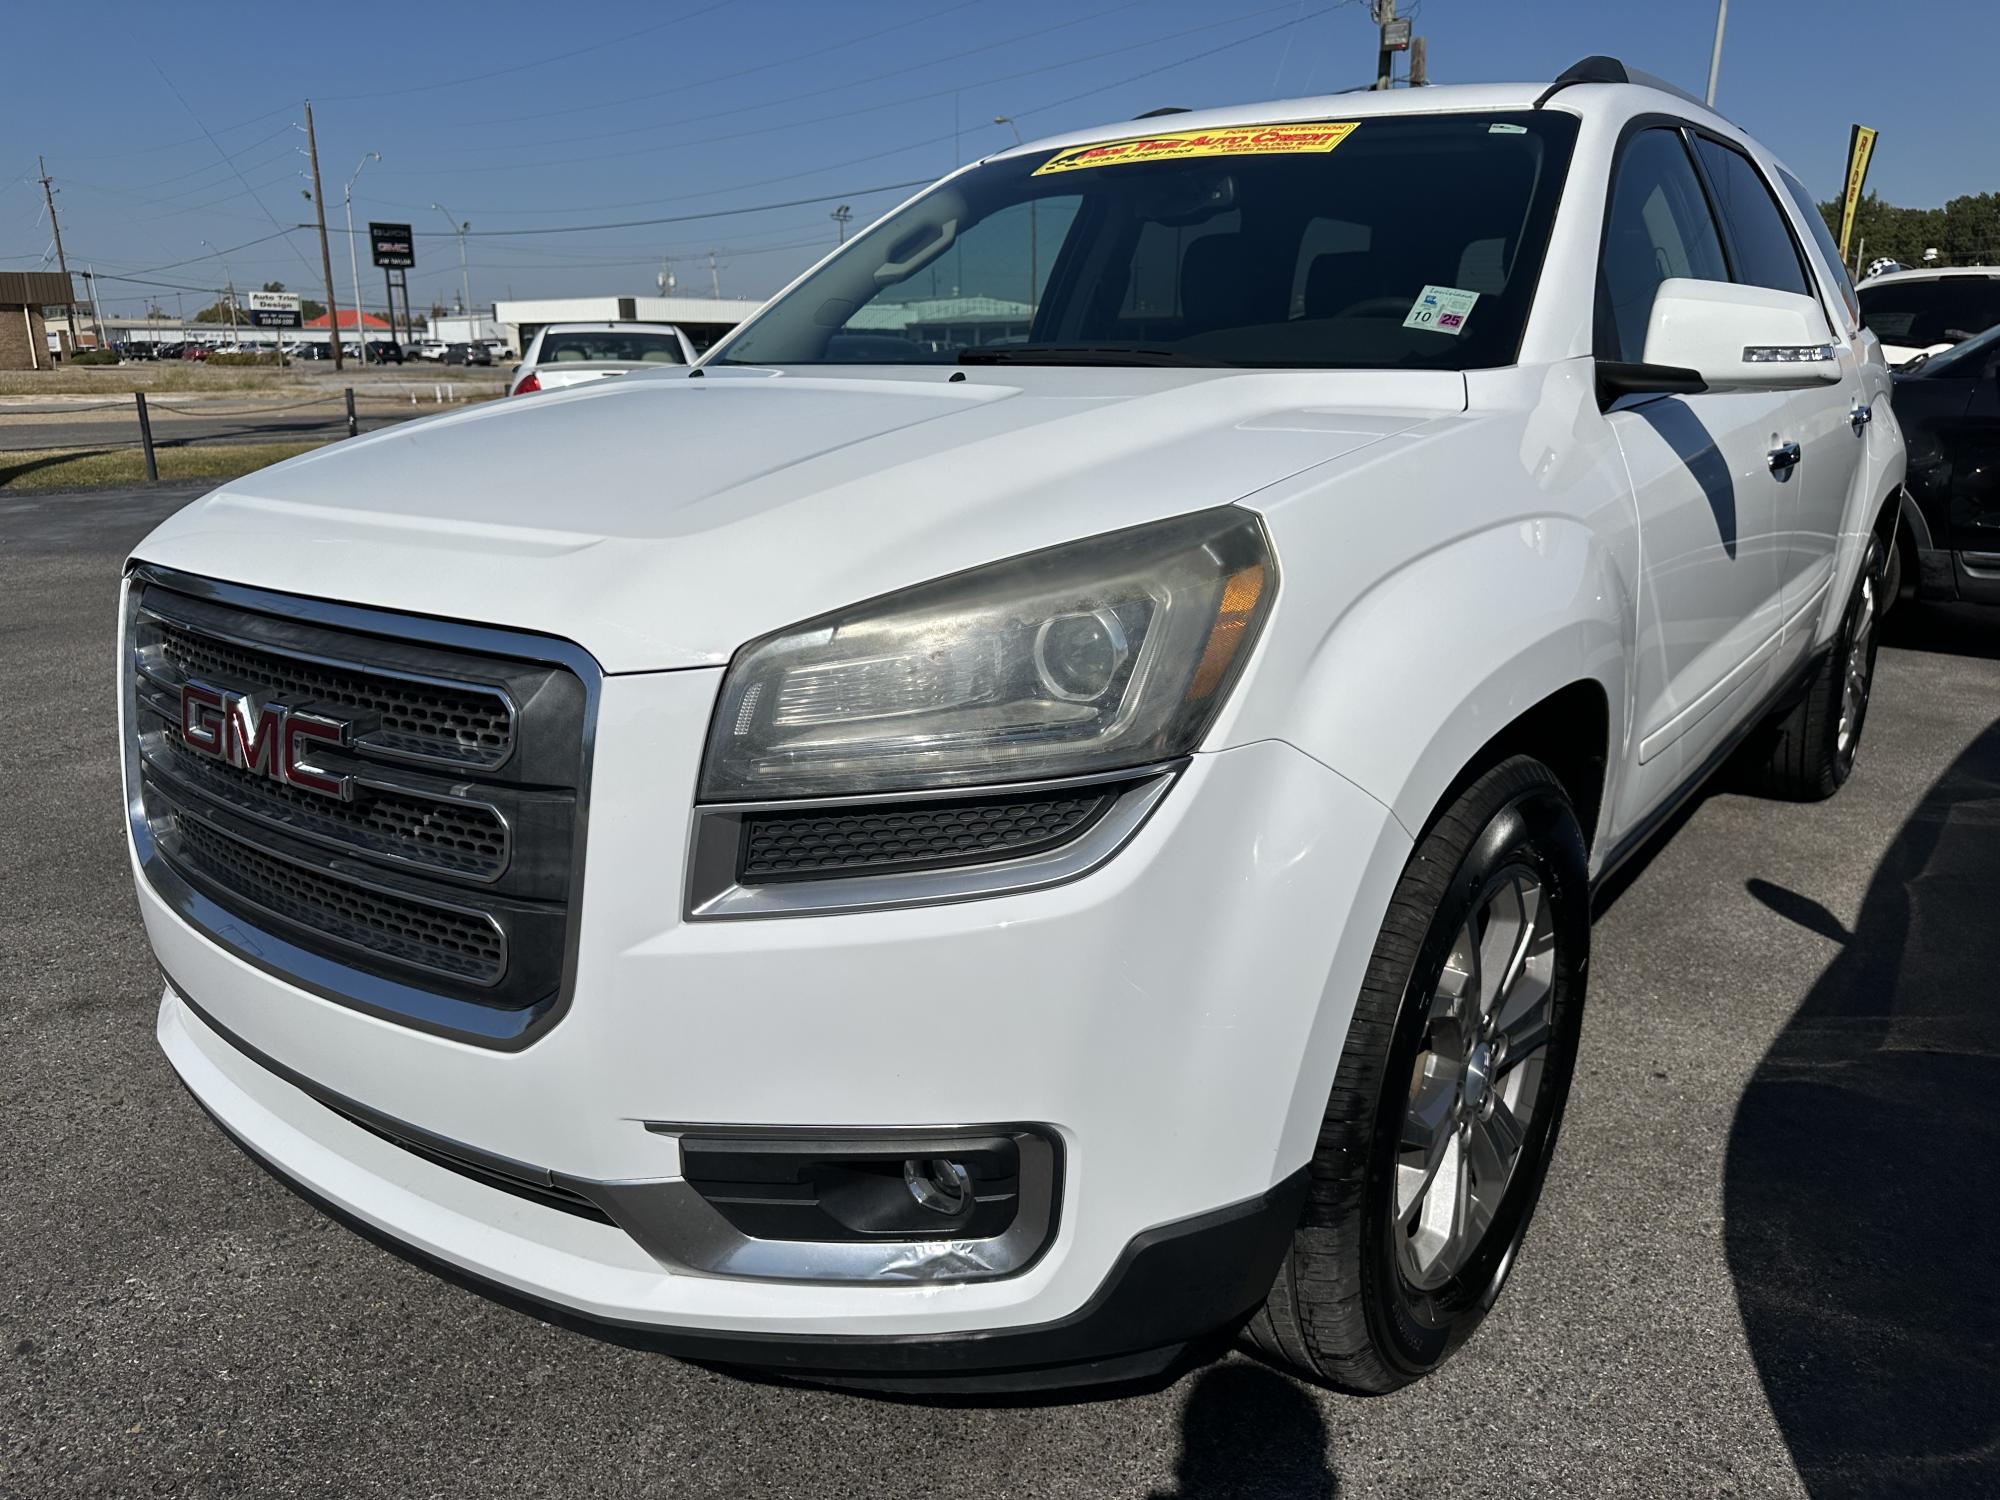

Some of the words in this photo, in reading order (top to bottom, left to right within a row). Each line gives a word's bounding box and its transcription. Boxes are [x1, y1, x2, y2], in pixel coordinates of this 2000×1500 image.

[1183, 135, 1249, 147] AUTO
[377, 243, 410, 253] GMC
[260, 301, 293, 309] Design
[1414, 311, 1432, 322] 10
[1440, 313, 1461, 327] 25
[181, 678, 354, 803] GMC
